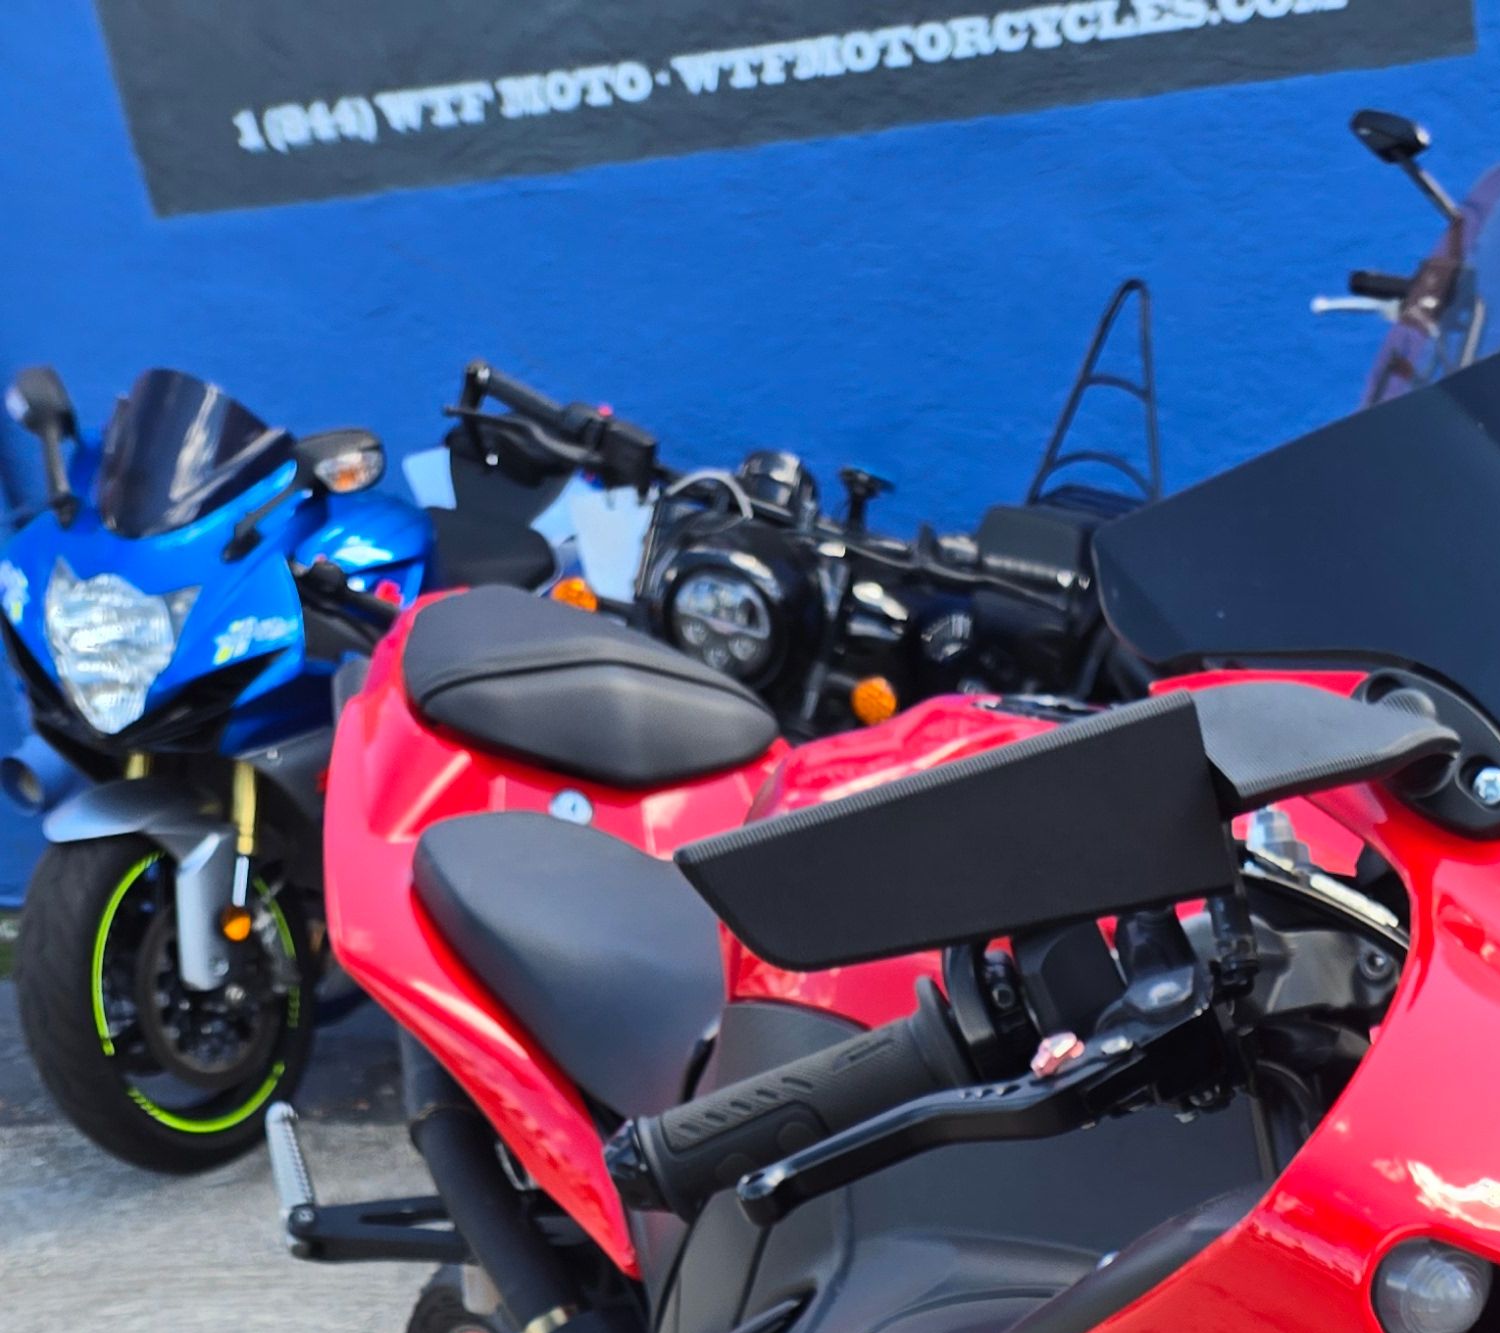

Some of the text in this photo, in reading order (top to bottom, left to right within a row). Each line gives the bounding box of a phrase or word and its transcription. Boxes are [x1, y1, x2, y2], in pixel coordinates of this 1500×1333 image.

[373, 81, 492, 134] WTF
[495, 61, 652, 119] MOTO
[669, 0, 1348, 95] WTFMOTORCYCLES.C
